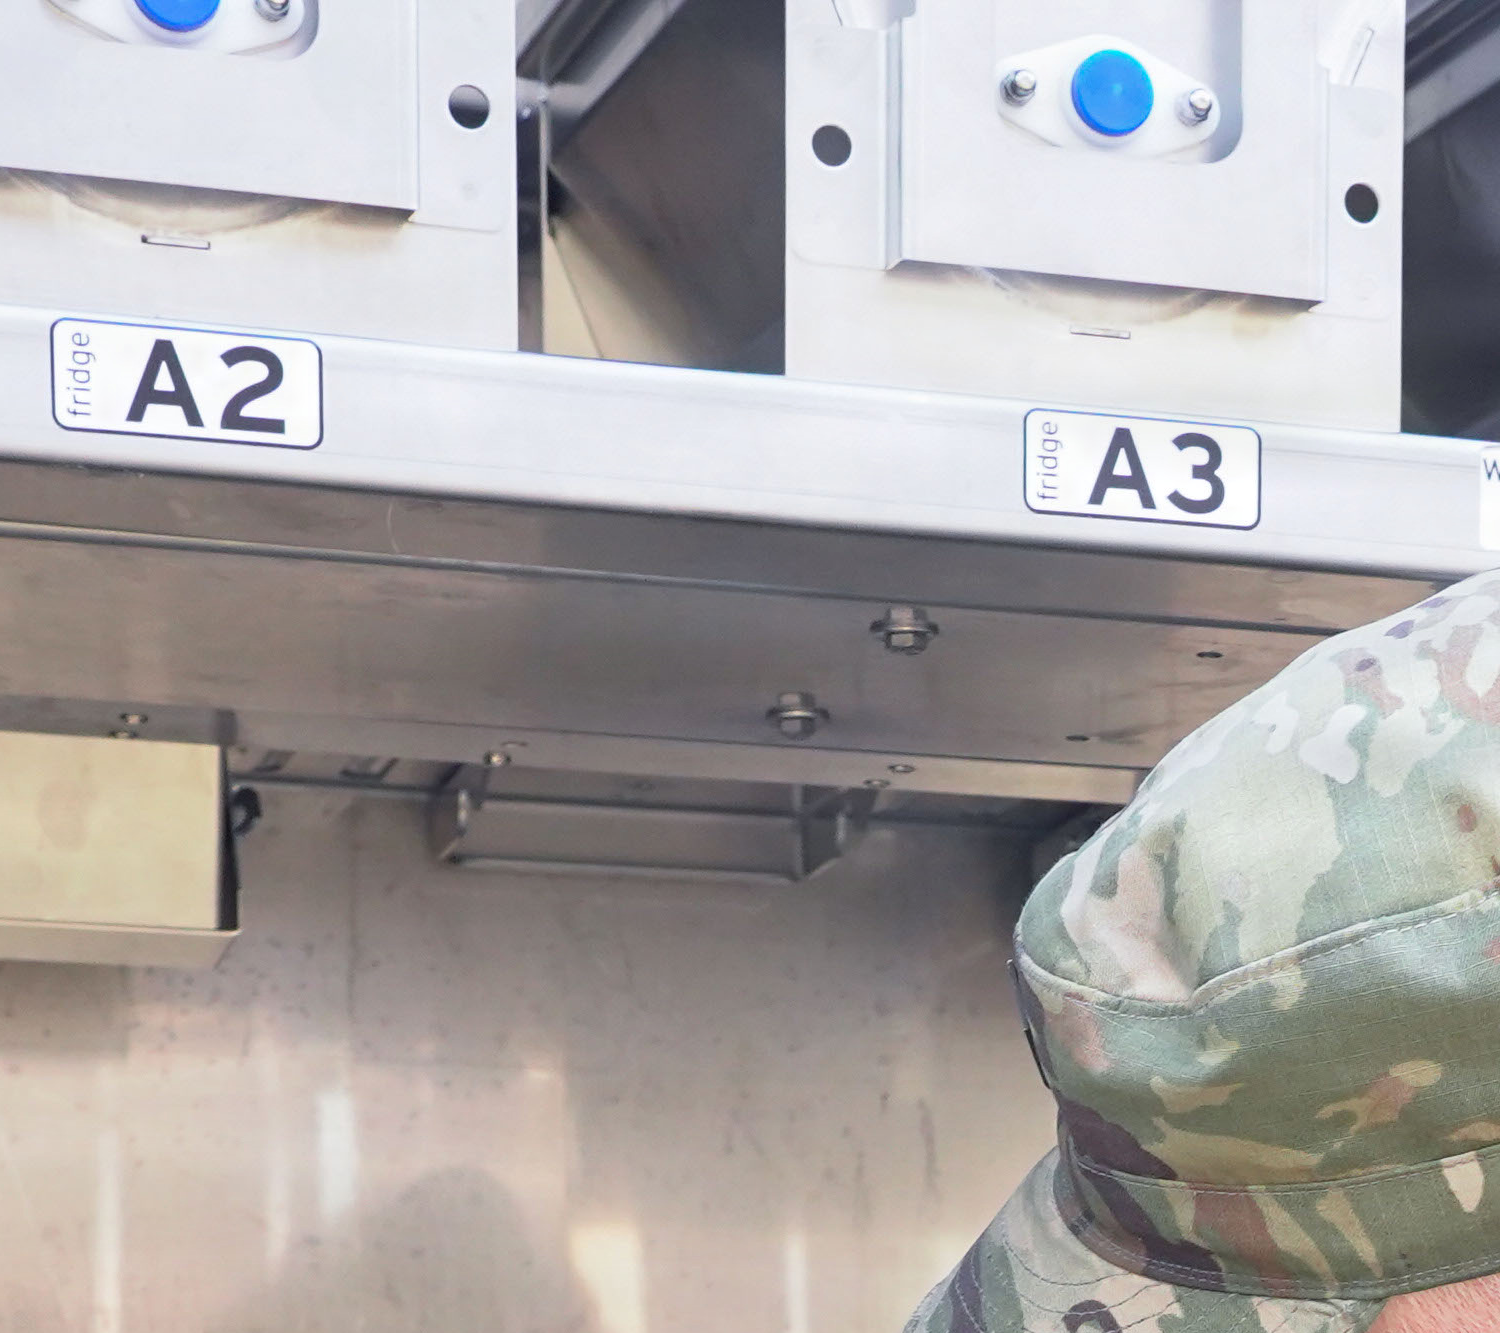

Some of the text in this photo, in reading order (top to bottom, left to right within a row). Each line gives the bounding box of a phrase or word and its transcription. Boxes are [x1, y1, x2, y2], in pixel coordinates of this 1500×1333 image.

[66, 331, 97, 417] fridge
[125, 338, 287, 435] A2
[1036, 420, 1064, 501] fridge
[1087, 426, 1226, 515] A3
